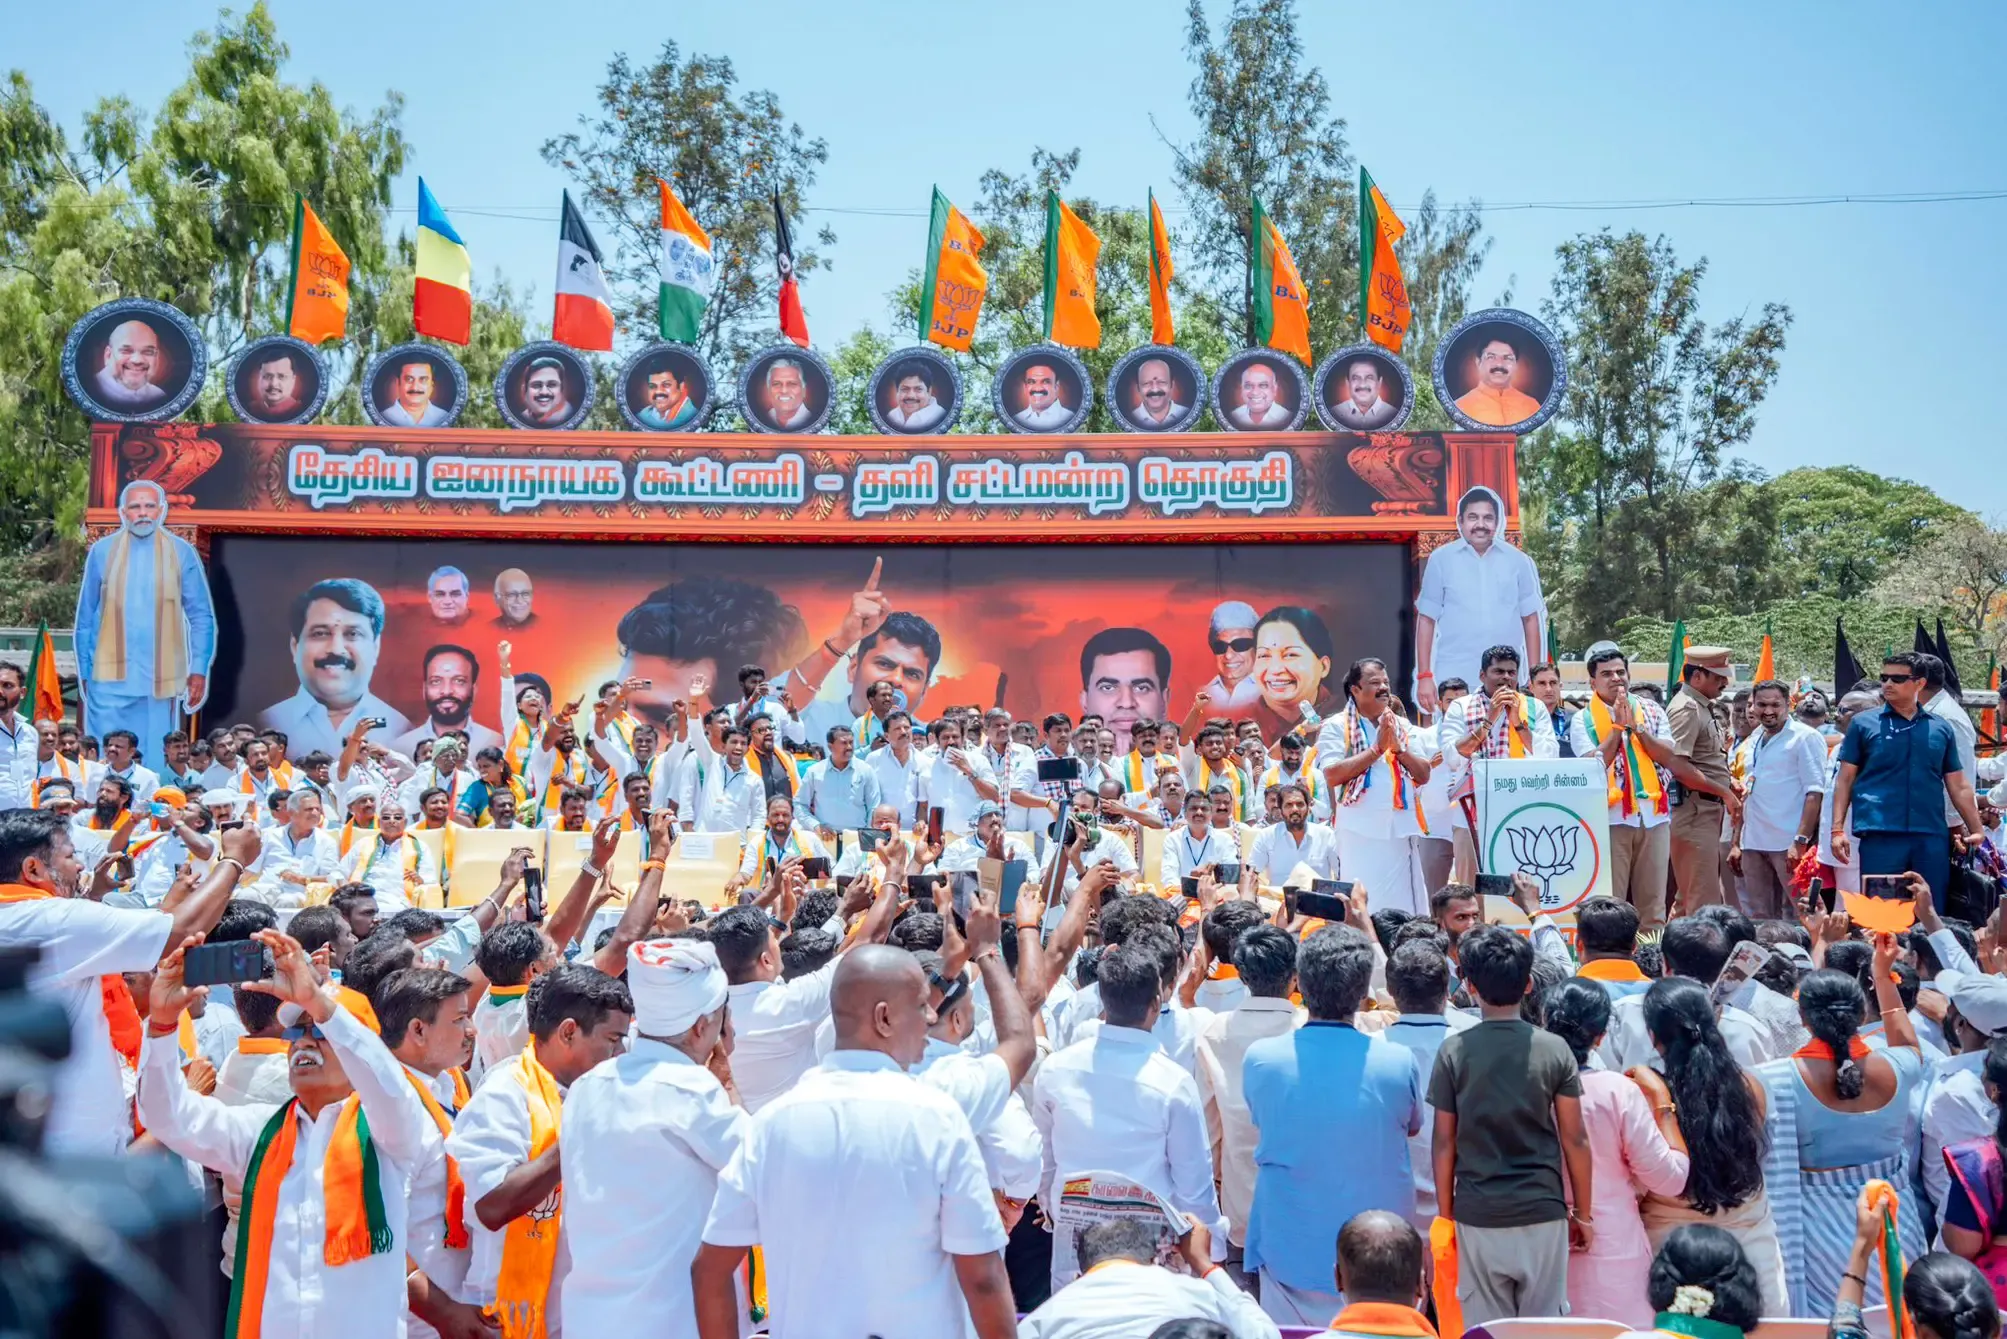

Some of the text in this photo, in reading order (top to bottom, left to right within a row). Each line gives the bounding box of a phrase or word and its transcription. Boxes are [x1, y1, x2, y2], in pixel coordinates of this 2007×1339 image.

[1369, 312, 1403, 335] BJP
[292, 449, 414, 504] தேசிய
[429, 460, 622, 507] ஜனநாயக
[637, 457, 801, 499] கூட்டணி
[950, 455, 1126, 511] சட்டமன்ற
[1142, 455, 1289, 510] தொகுதி
[1493, 773, 1588, 793] நமது வெற்றி சின்னம்
